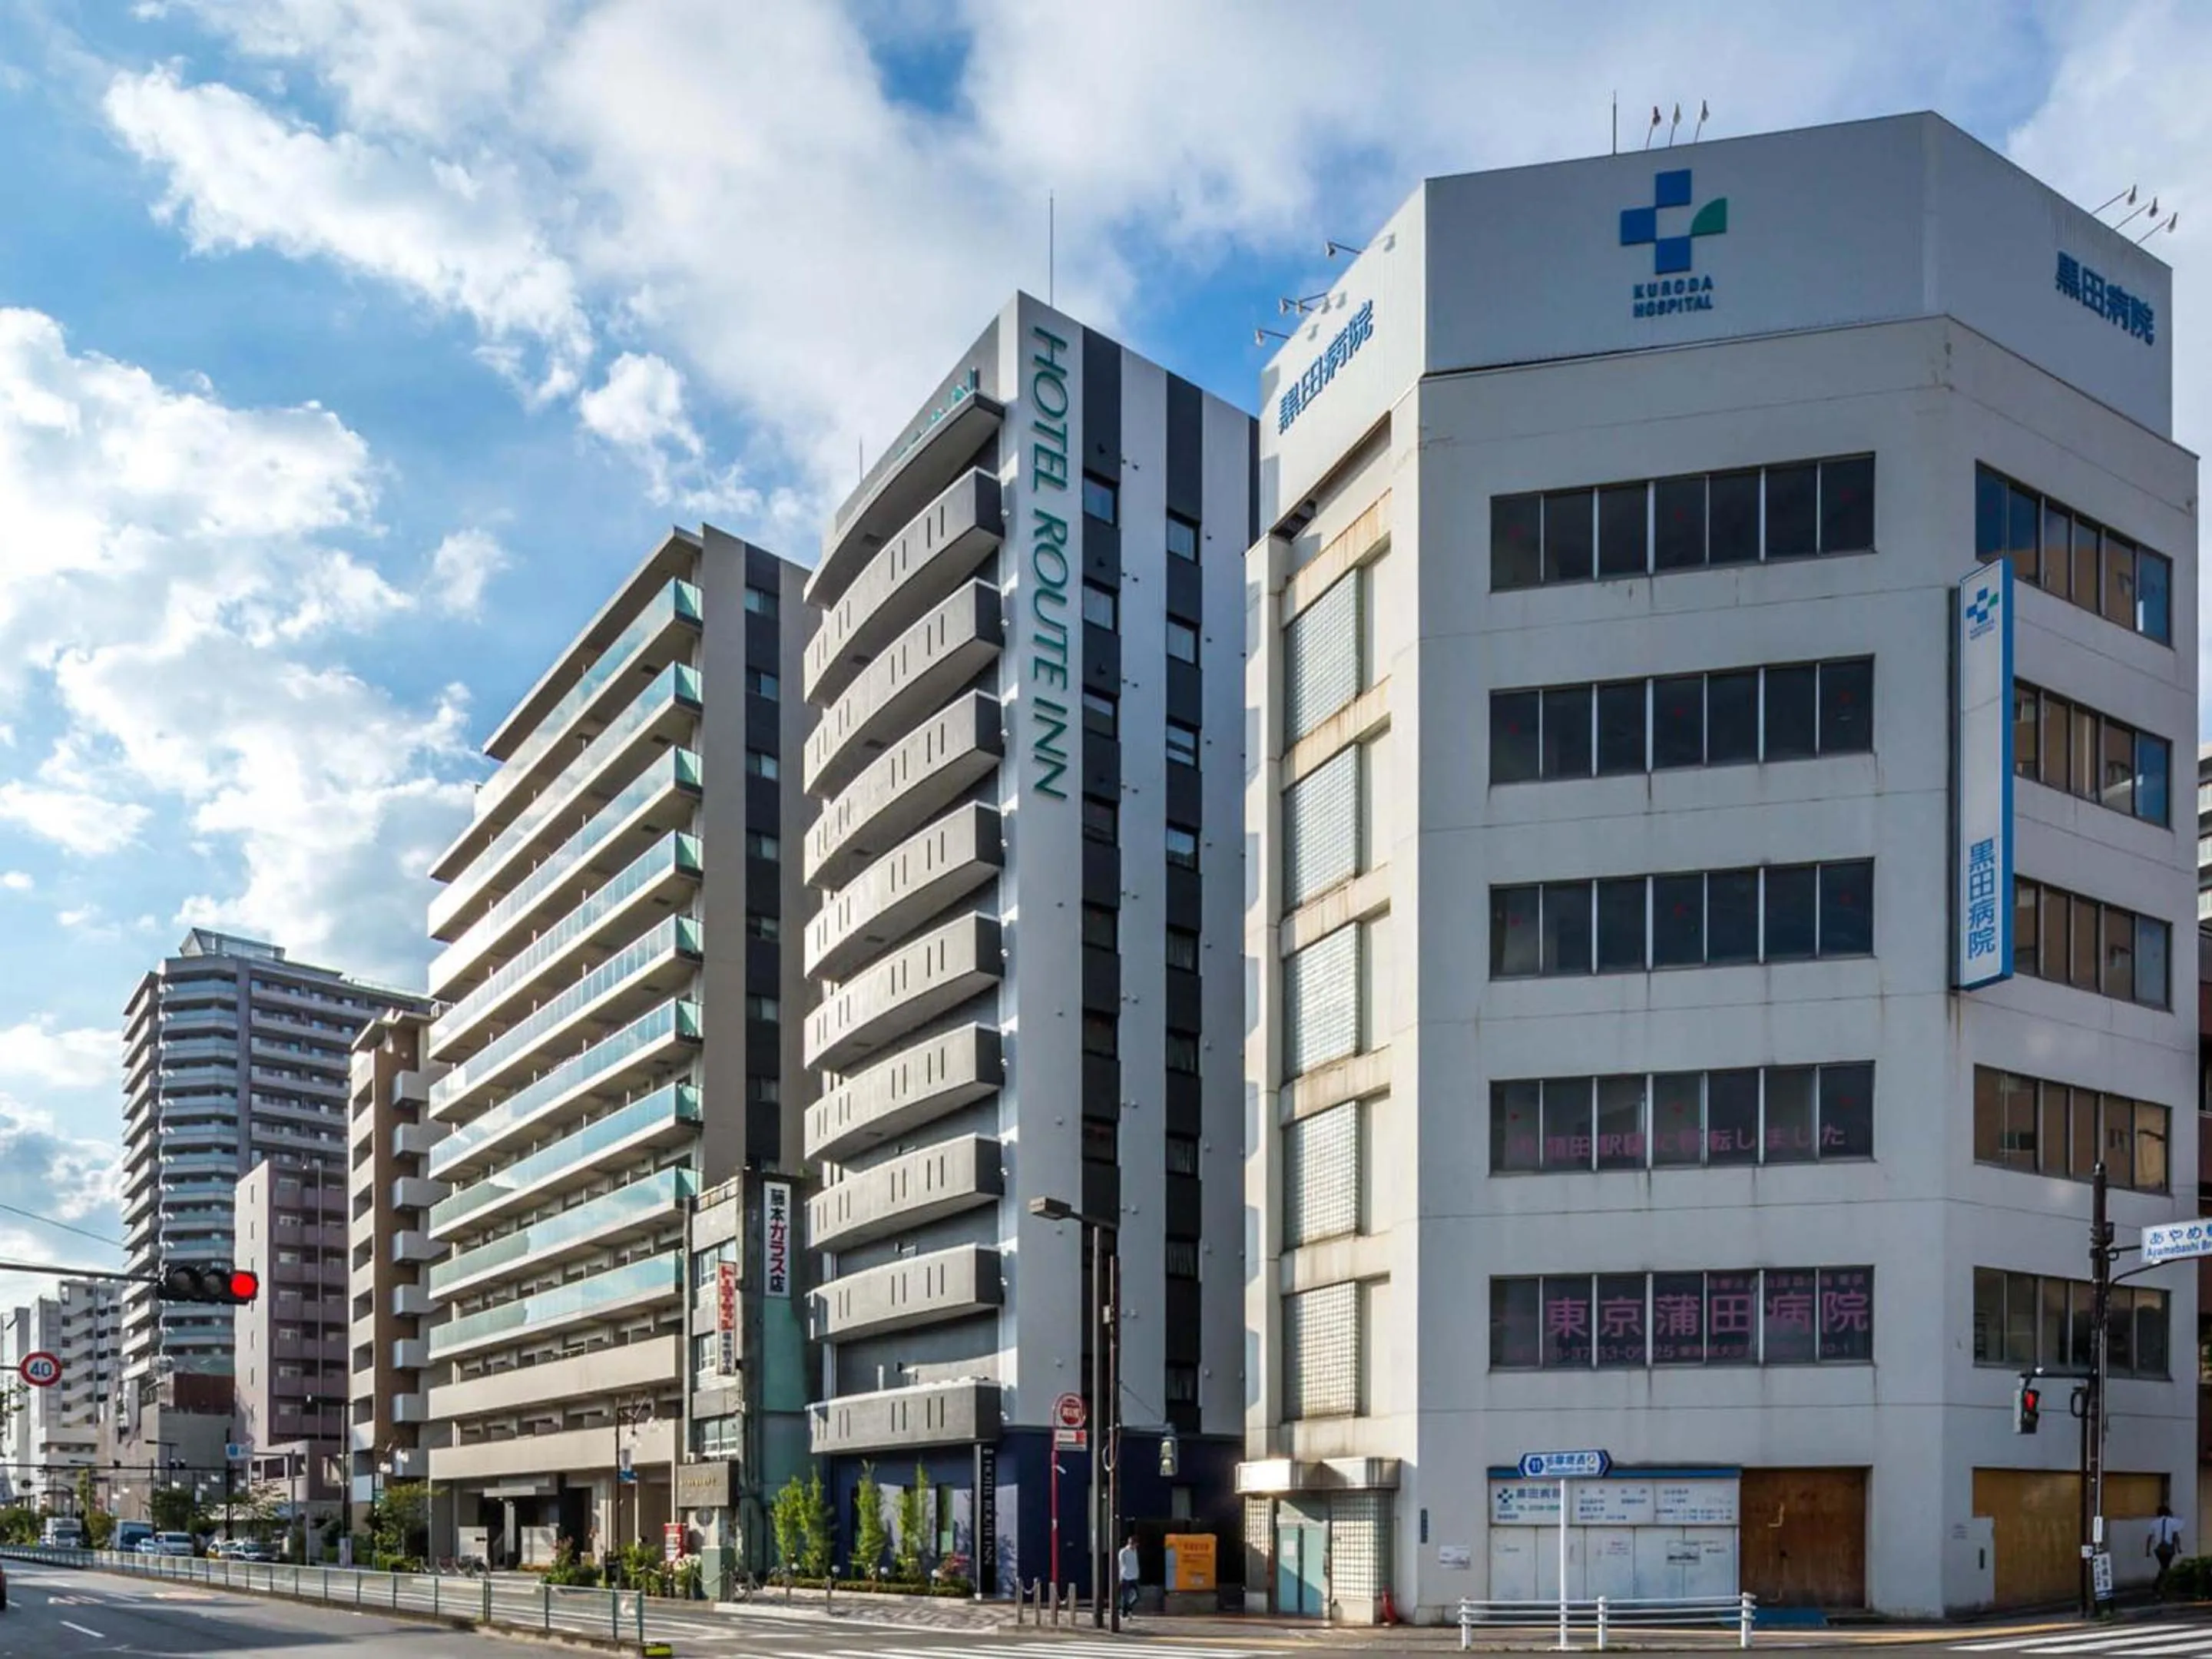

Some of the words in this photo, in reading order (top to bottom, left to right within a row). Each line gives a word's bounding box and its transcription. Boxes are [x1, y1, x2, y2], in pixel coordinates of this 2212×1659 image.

[1634, 275, 1713, 299] KURODA
[1634, 293, 1713, 318] HOSPITAL
[2055, 250, 2154, 346] 黒田病院
[1034, 326, 1068, 492] HOTEL
[1278, 299, 1373, 436] 黒田病院
[1033, 508, 1068, 690] ROUTE
[1033, 697, 1068, 800] INN
[1968, 838, 1996, 960] 黒田病院
[1545, 1291, 1870, 1339] 東京蒲田病院
[30, 1362, 53, 1377] 40
